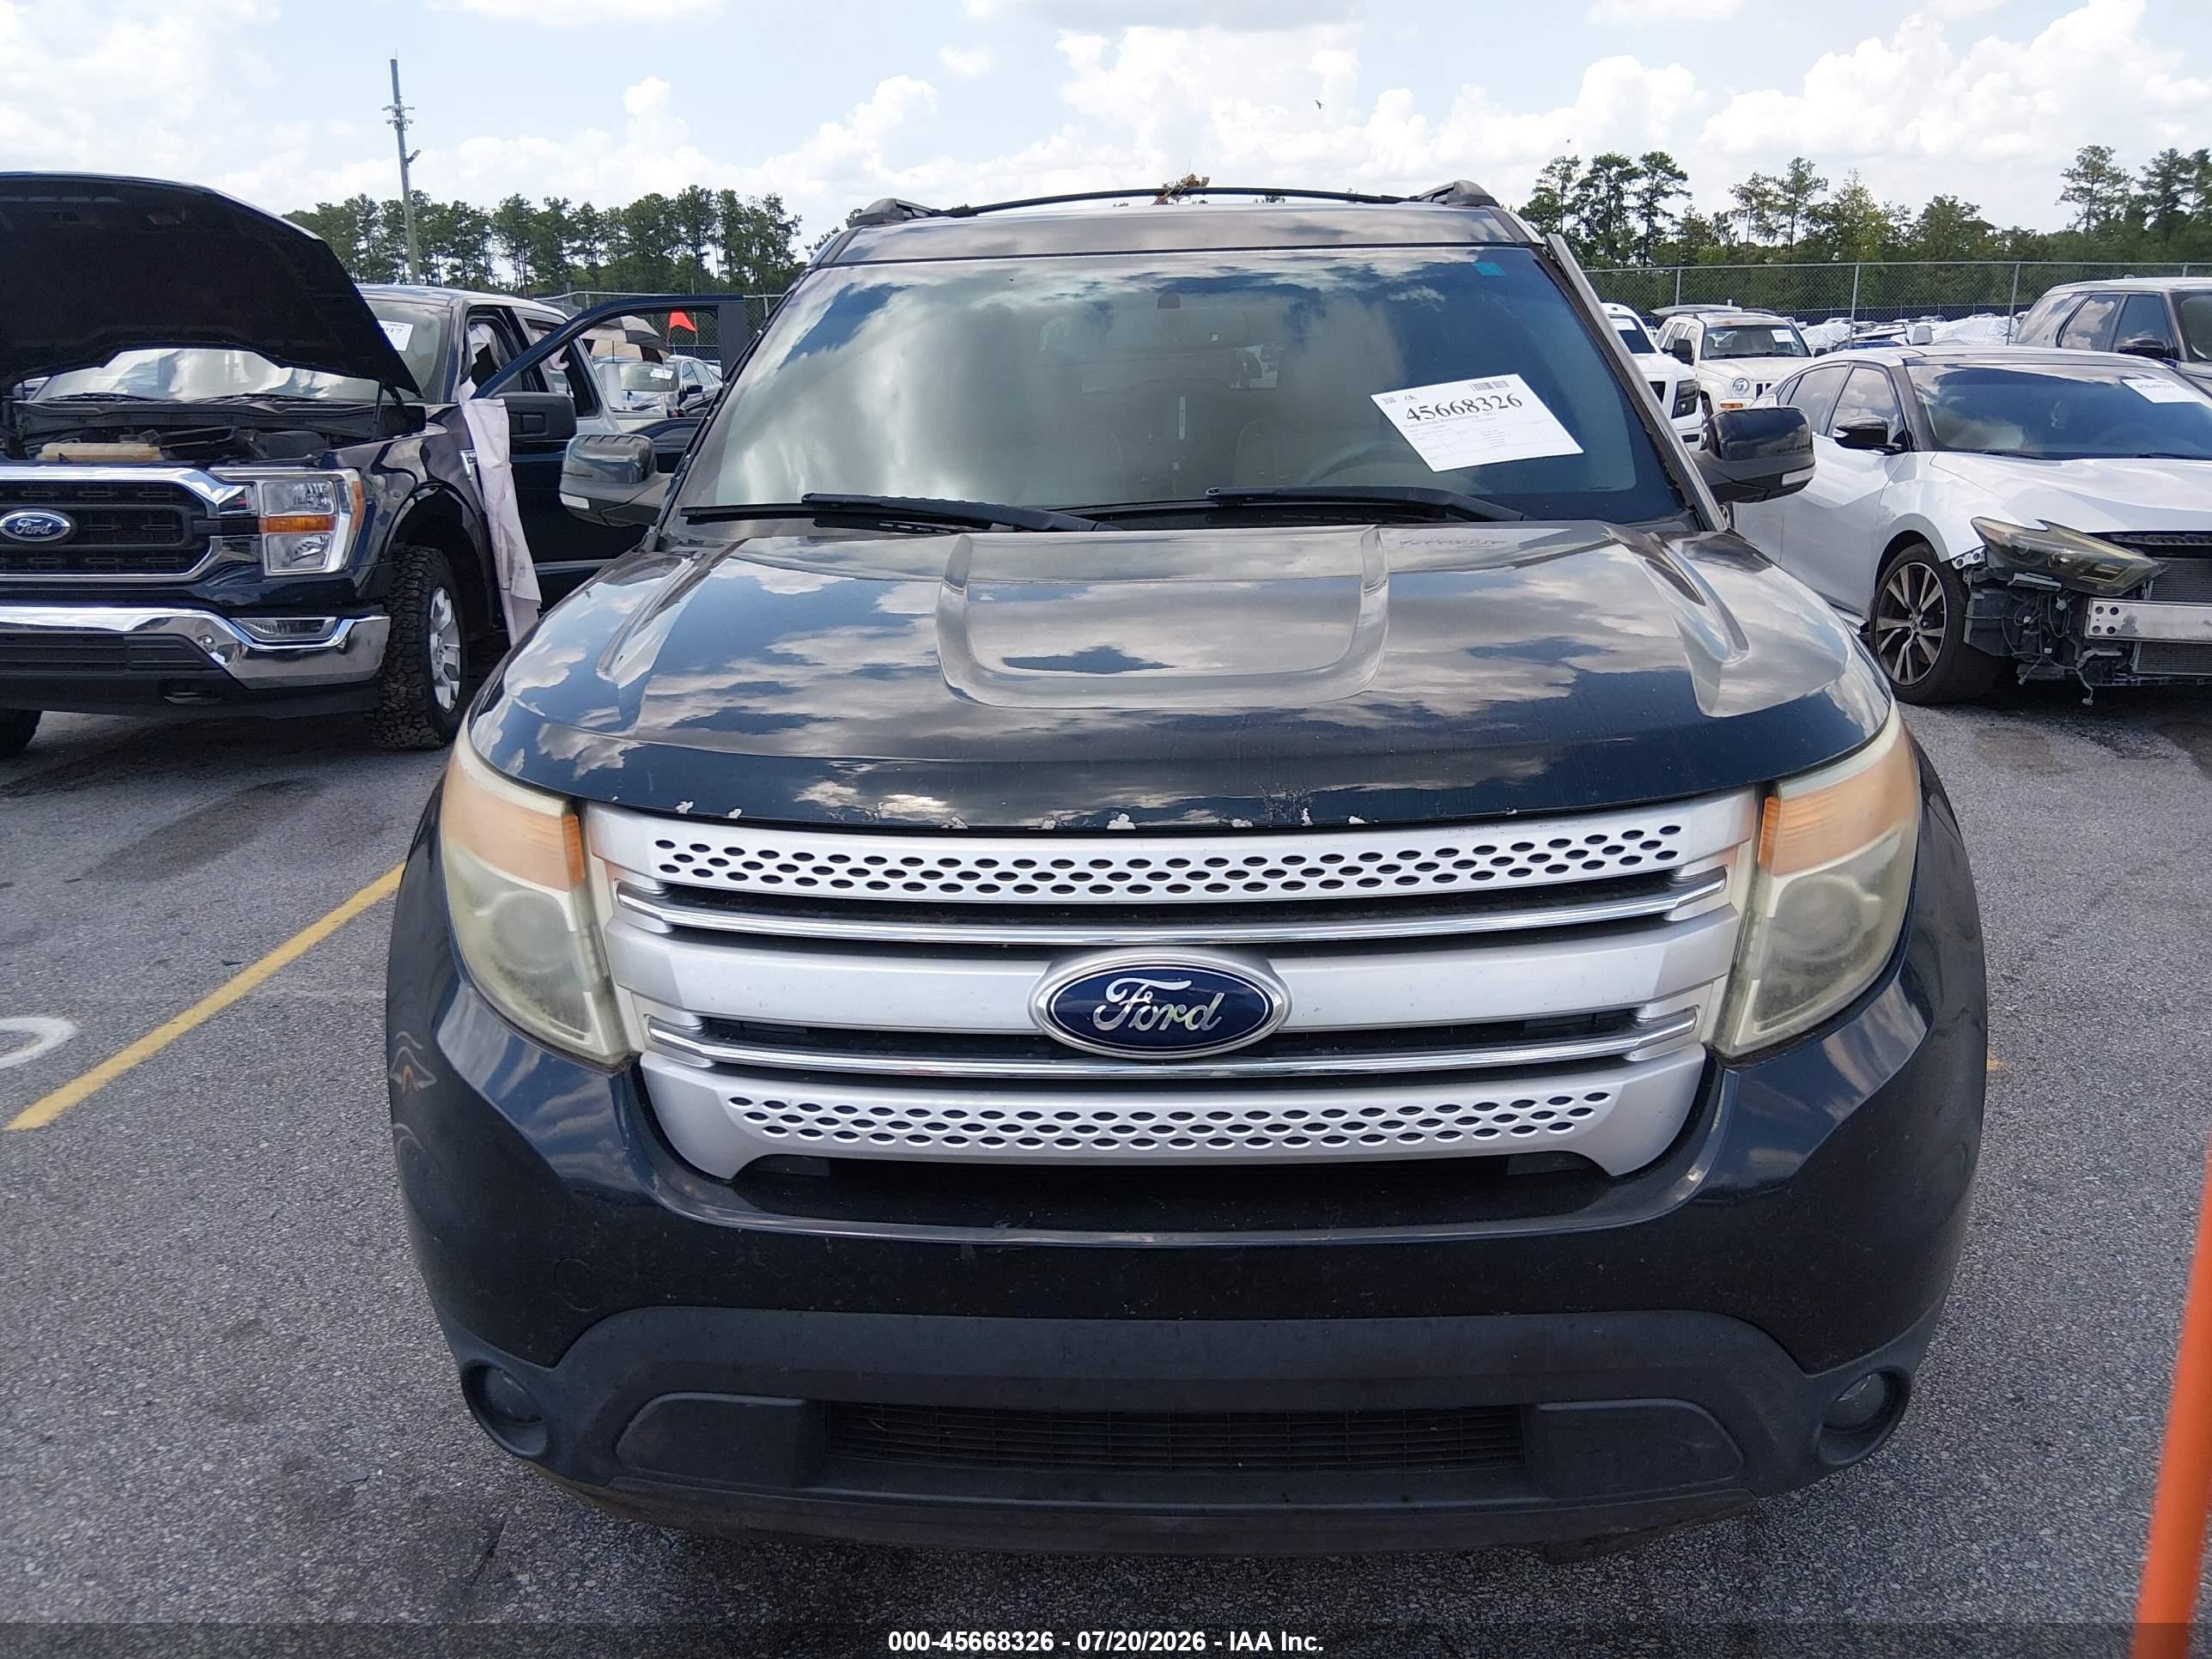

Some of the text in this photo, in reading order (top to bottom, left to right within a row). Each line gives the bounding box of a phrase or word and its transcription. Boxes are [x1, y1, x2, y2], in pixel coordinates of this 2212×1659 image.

[1407, 392, 1522, 421] 45668326
[15, 518, 52, 535] Ford
[1092, 977, 1225, 1031] Ford
